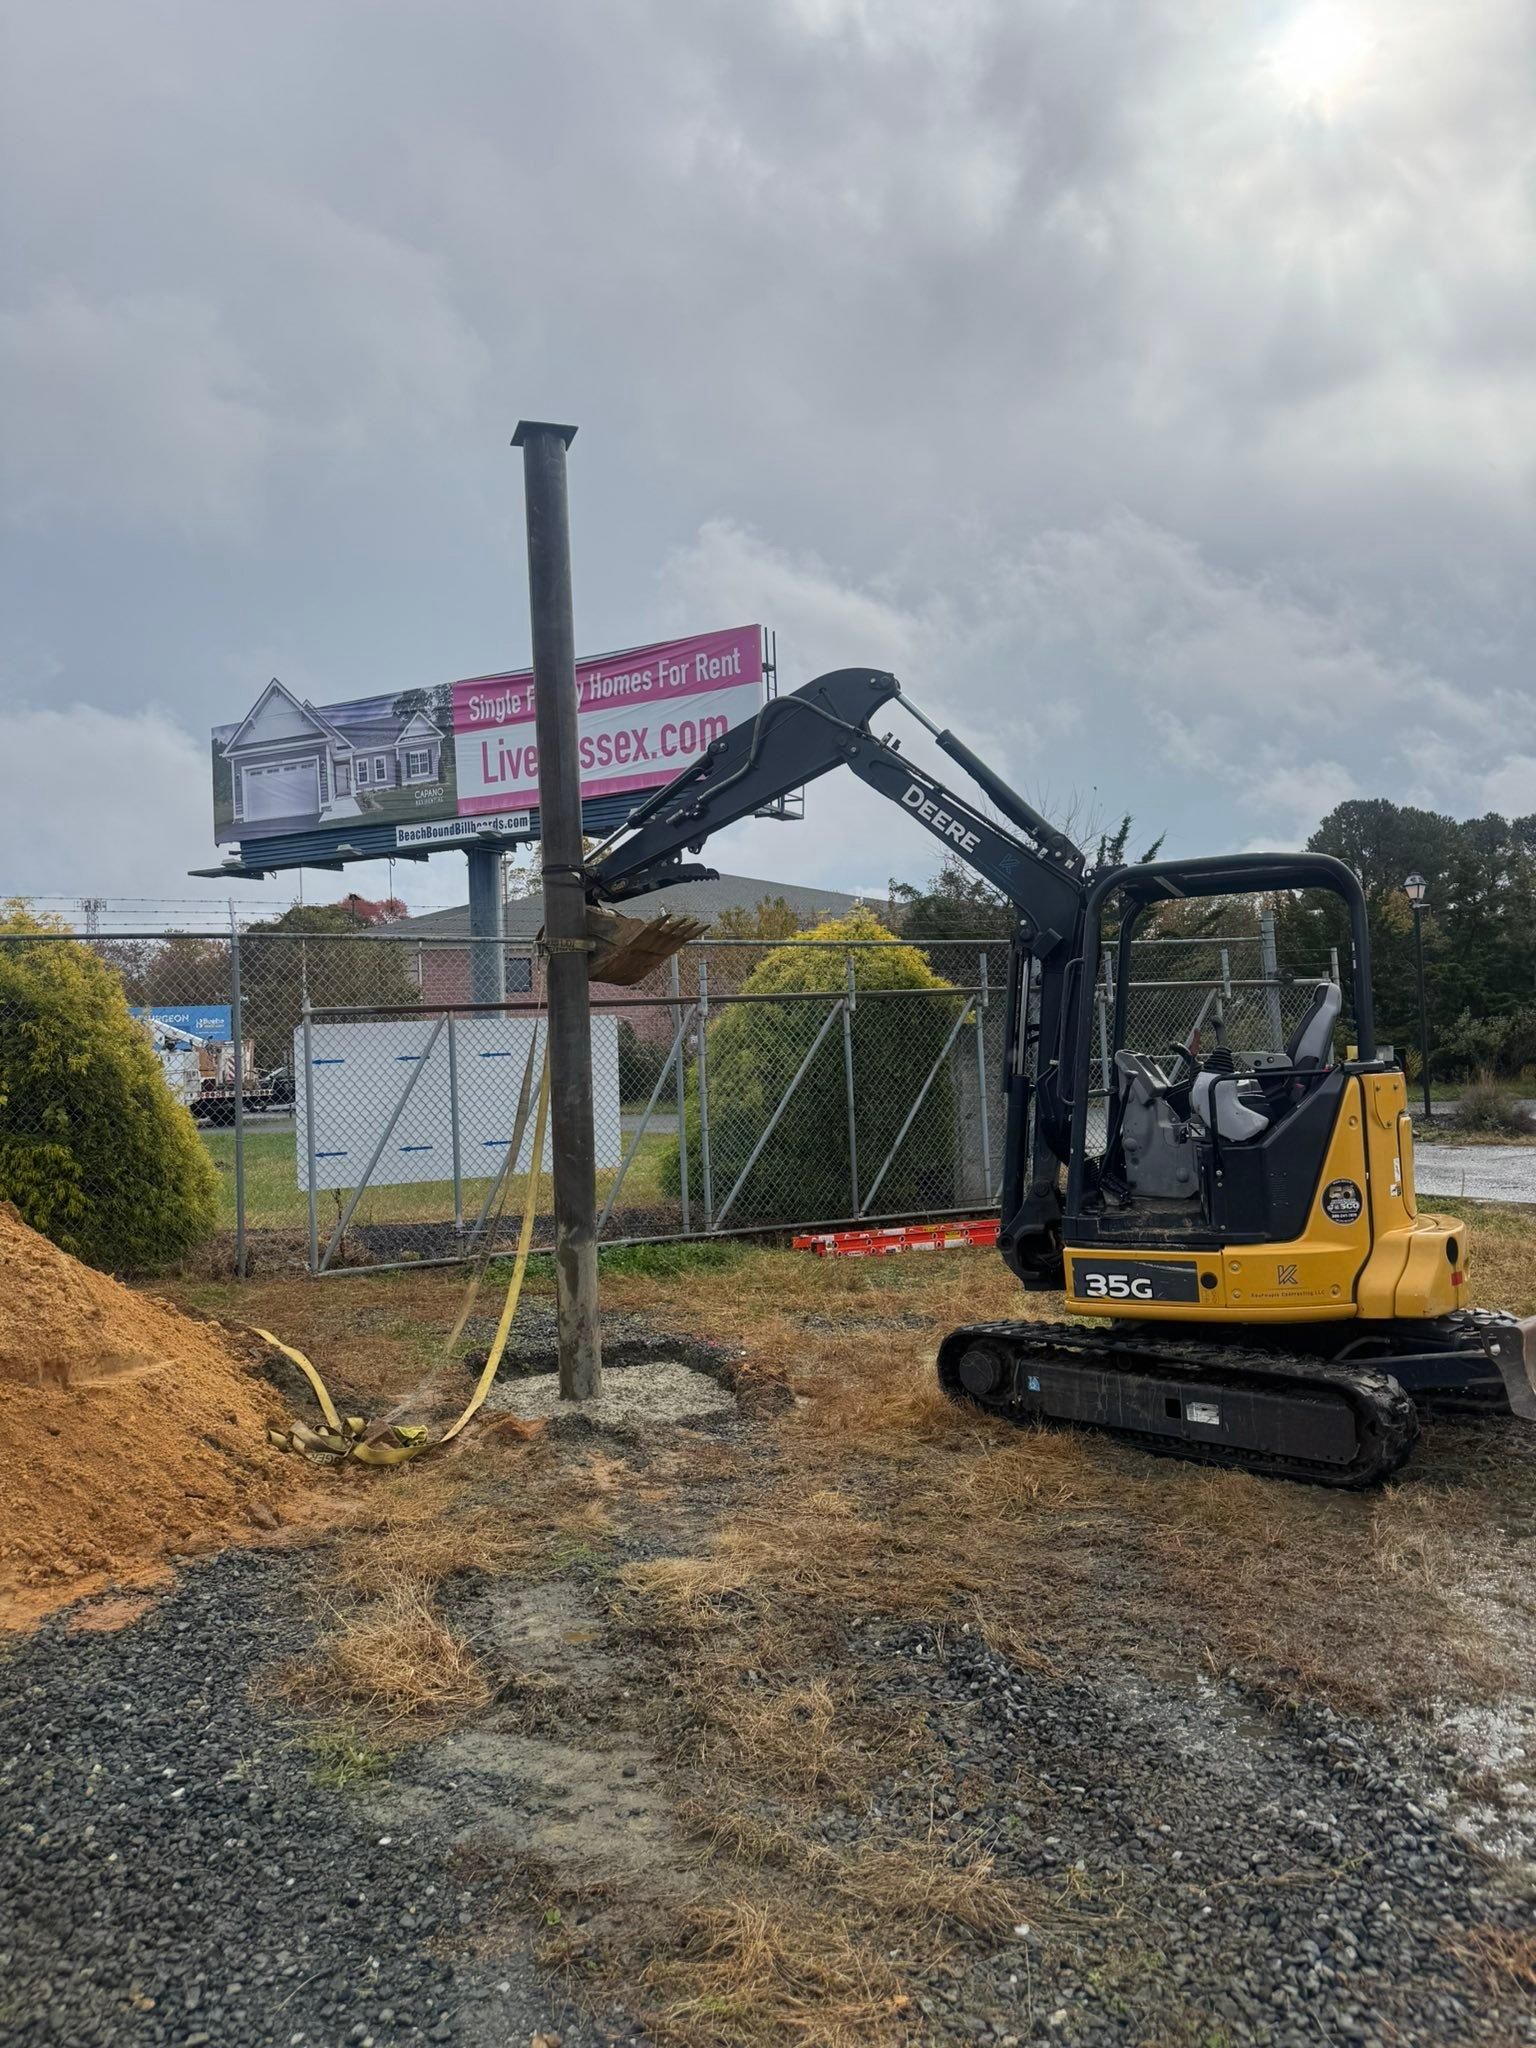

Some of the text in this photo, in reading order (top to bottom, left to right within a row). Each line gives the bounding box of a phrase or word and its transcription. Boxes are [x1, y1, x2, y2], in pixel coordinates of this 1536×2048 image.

[468, 690, 521, 723] Single
[590, 670, 652, 700] Homes
[658, 660, 690, 688] For
[695, 647, 741, 682] Rent
[481, 714, 728, 784] Livessex.com
[414, 787, 444, 799] CAPANO
[901, 784, 981, 854] DEERE
[1085, 1273, 1153, 1299] 35G
